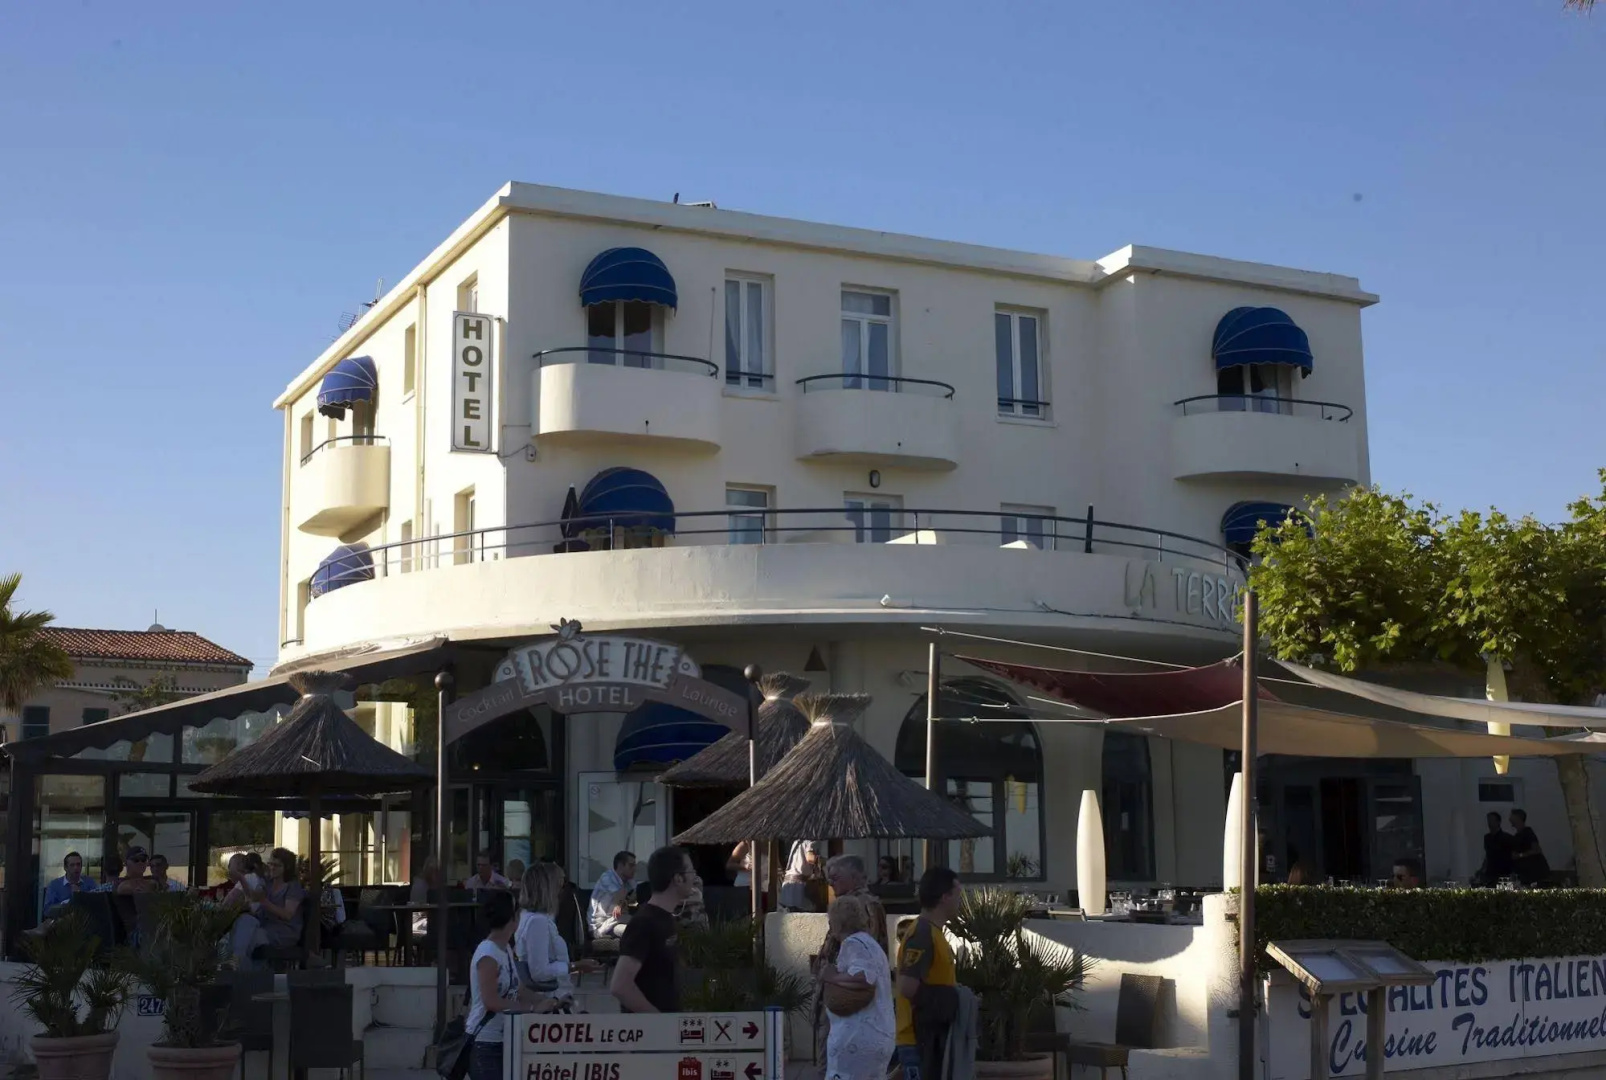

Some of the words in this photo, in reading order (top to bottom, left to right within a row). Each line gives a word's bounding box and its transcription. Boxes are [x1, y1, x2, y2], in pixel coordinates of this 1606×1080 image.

[462, 318, 483, 447] HOTEL
[1124, 560, 1157, 610] LA
[527, 640, 611, 686] ROSE
[623, 641, 669, 684] THE
[458, 689, 514, 722] Cocktail
[682, 684, 738, 717] Lounge
[558, 686, 634, 706] HOTEL
[140, 998, 162, 1013] 247
[528, 1022, 594, 1043] CIOTEL
[600, 1029, 614, 1042] LE
[618, 1029, 644, 1043] CAP
[1330, 1019, 1438, 1074] Cusine
[527, 1062, 578, 1080] Hôtel
[584, 1062, 621, 1080] IBIS
[682, 1067, 698, 1076] ibis
